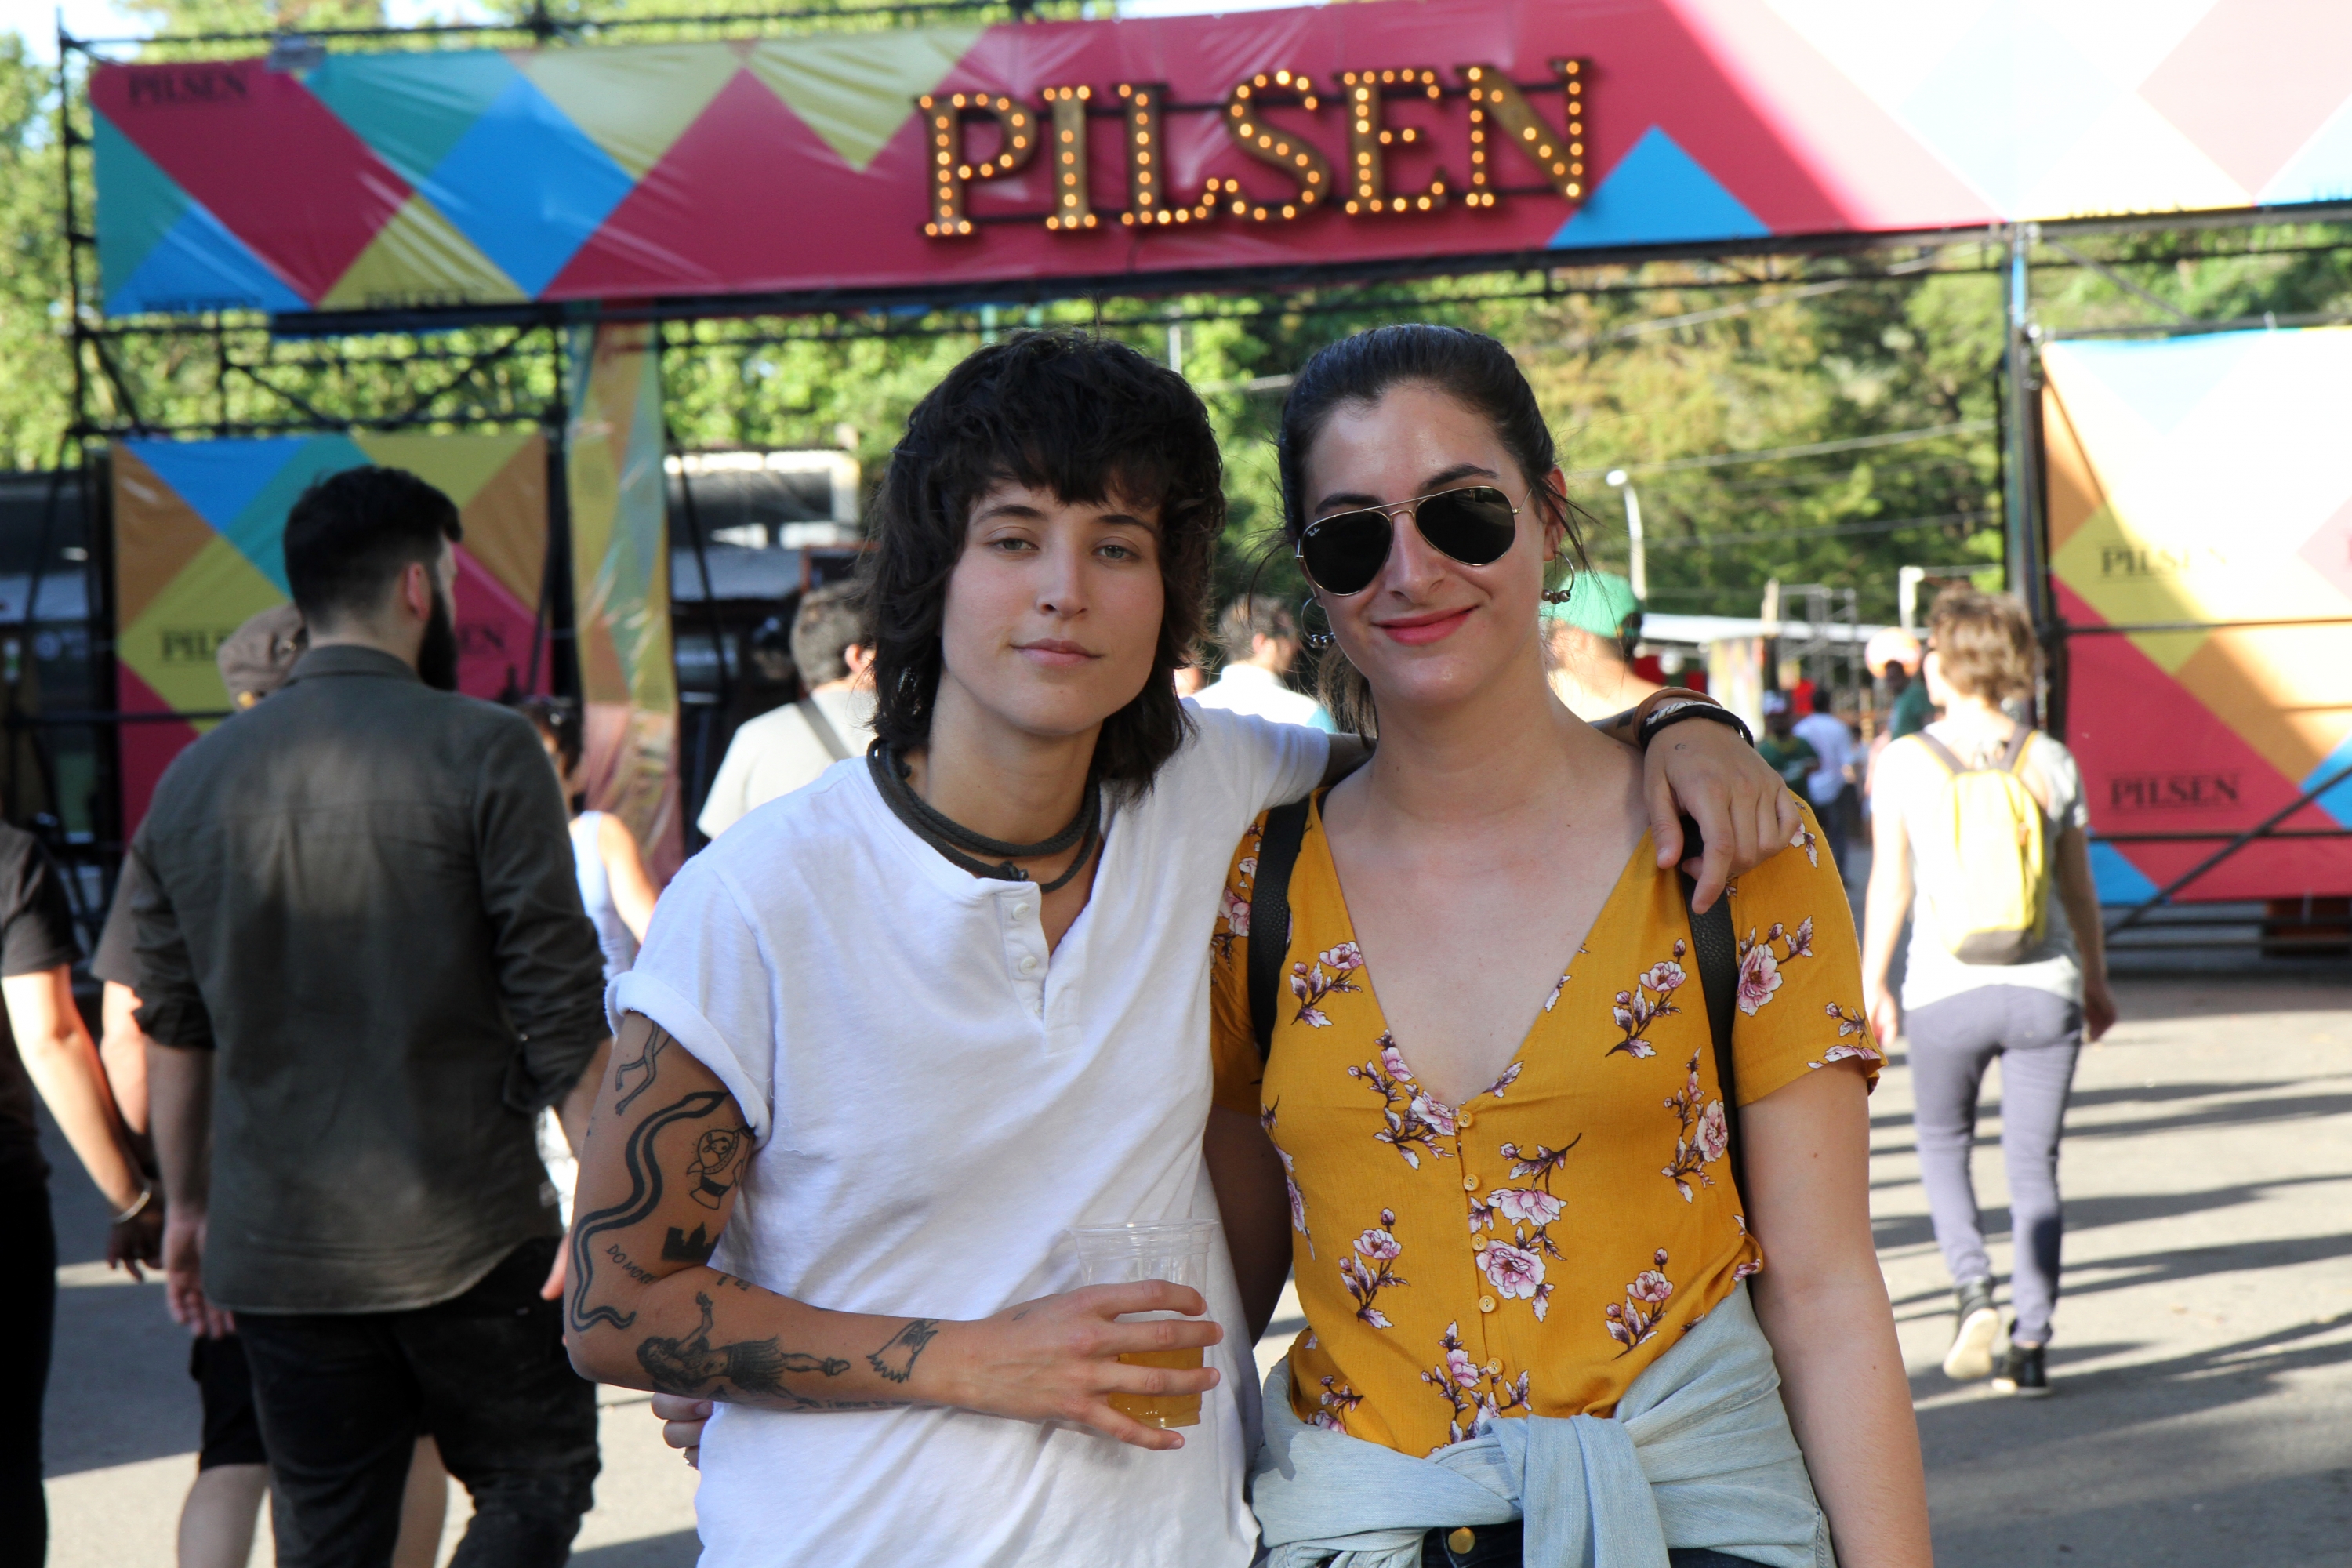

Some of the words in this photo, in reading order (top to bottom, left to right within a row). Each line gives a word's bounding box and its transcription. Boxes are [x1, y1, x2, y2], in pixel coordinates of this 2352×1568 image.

[126, 65, 250, 107] PILSEN
[913, 57, 1592, 238] PILSEN
[2109, 772, 2241, 809] PILSEN
[604, 1243, 626, 1264] DO
